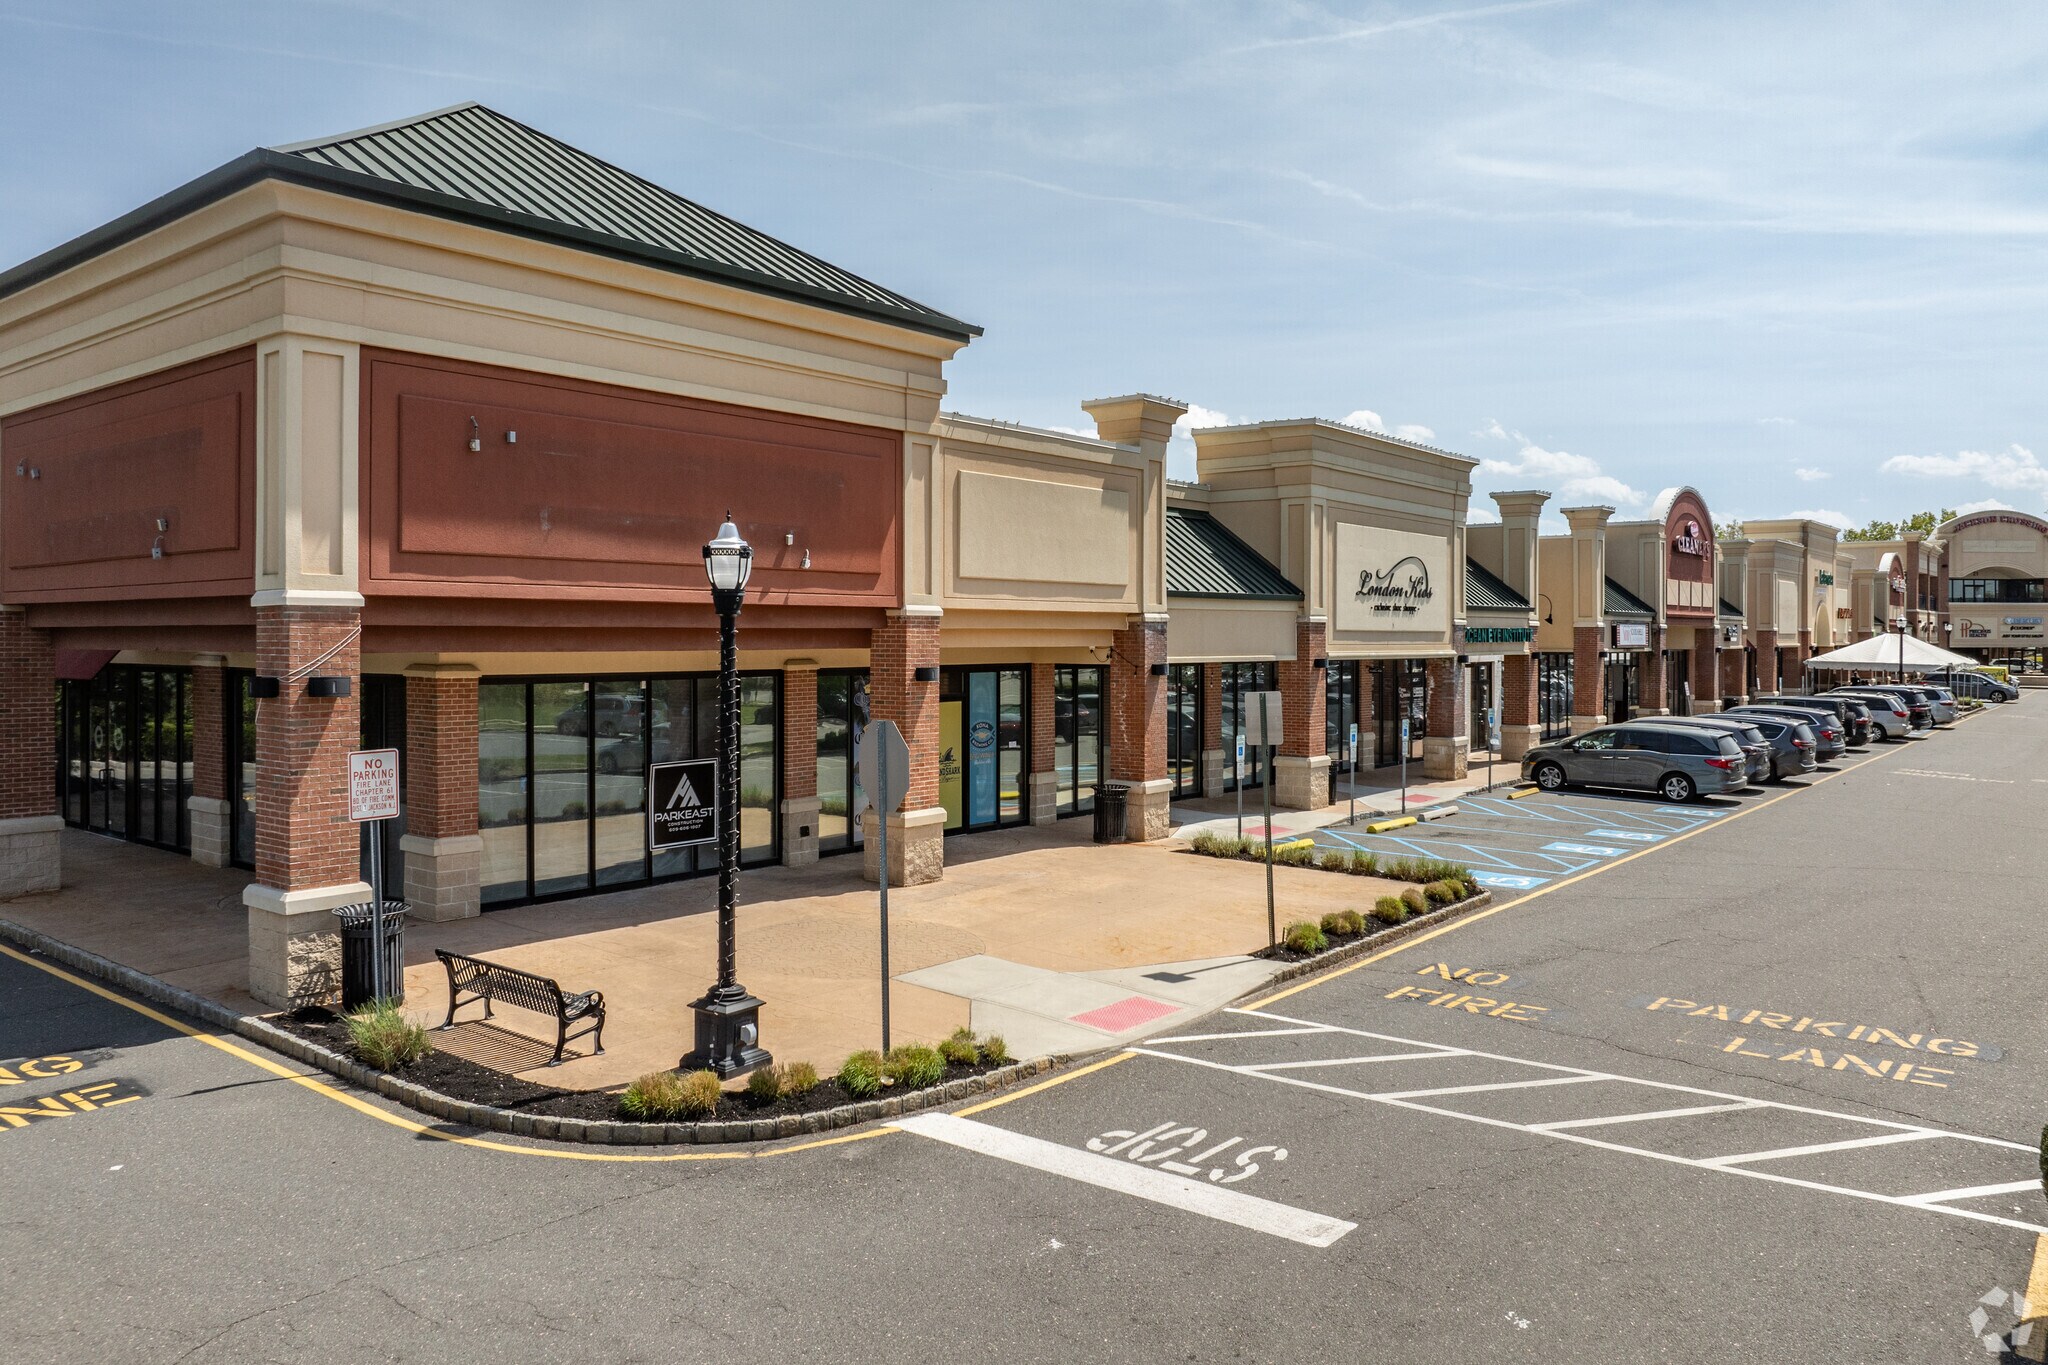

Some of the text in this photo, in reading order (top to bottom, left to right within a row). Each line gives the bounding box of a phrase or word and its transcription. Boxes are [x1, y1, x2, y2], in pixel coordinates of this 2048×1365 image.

[1952, 516, 2048, 534] JACKSON CROSSING
[1356, 570, 1404, 597] London
[1465, 628, 1487, 642] OCEAN
[1488, 628, 1502, 642] EYE
[365, 759, 382, 769] NO
[939, 767, 960, 776] NDSHARK
[353, 769, 394, 781] PARKING
[375, 779, 391, 787] LANE
[356, 788, 383, 796] CHAPTER
[368, 803, 387, 811] JACKSON
[655, 807, 714, 822] PARKEAST
[667, 819, 703, 827] CONSTRUCTION
[1416, 962, 1510, 986] NO
[1384, 986, 1551, 1021] FIRE
[1646, 997, 1979, 1057] PARKING
[1722, 1037, 1954, 1088] LANE
[0, 1083, 142, 1132] NE
[1086, 1121, 1288, 1183] STOP
